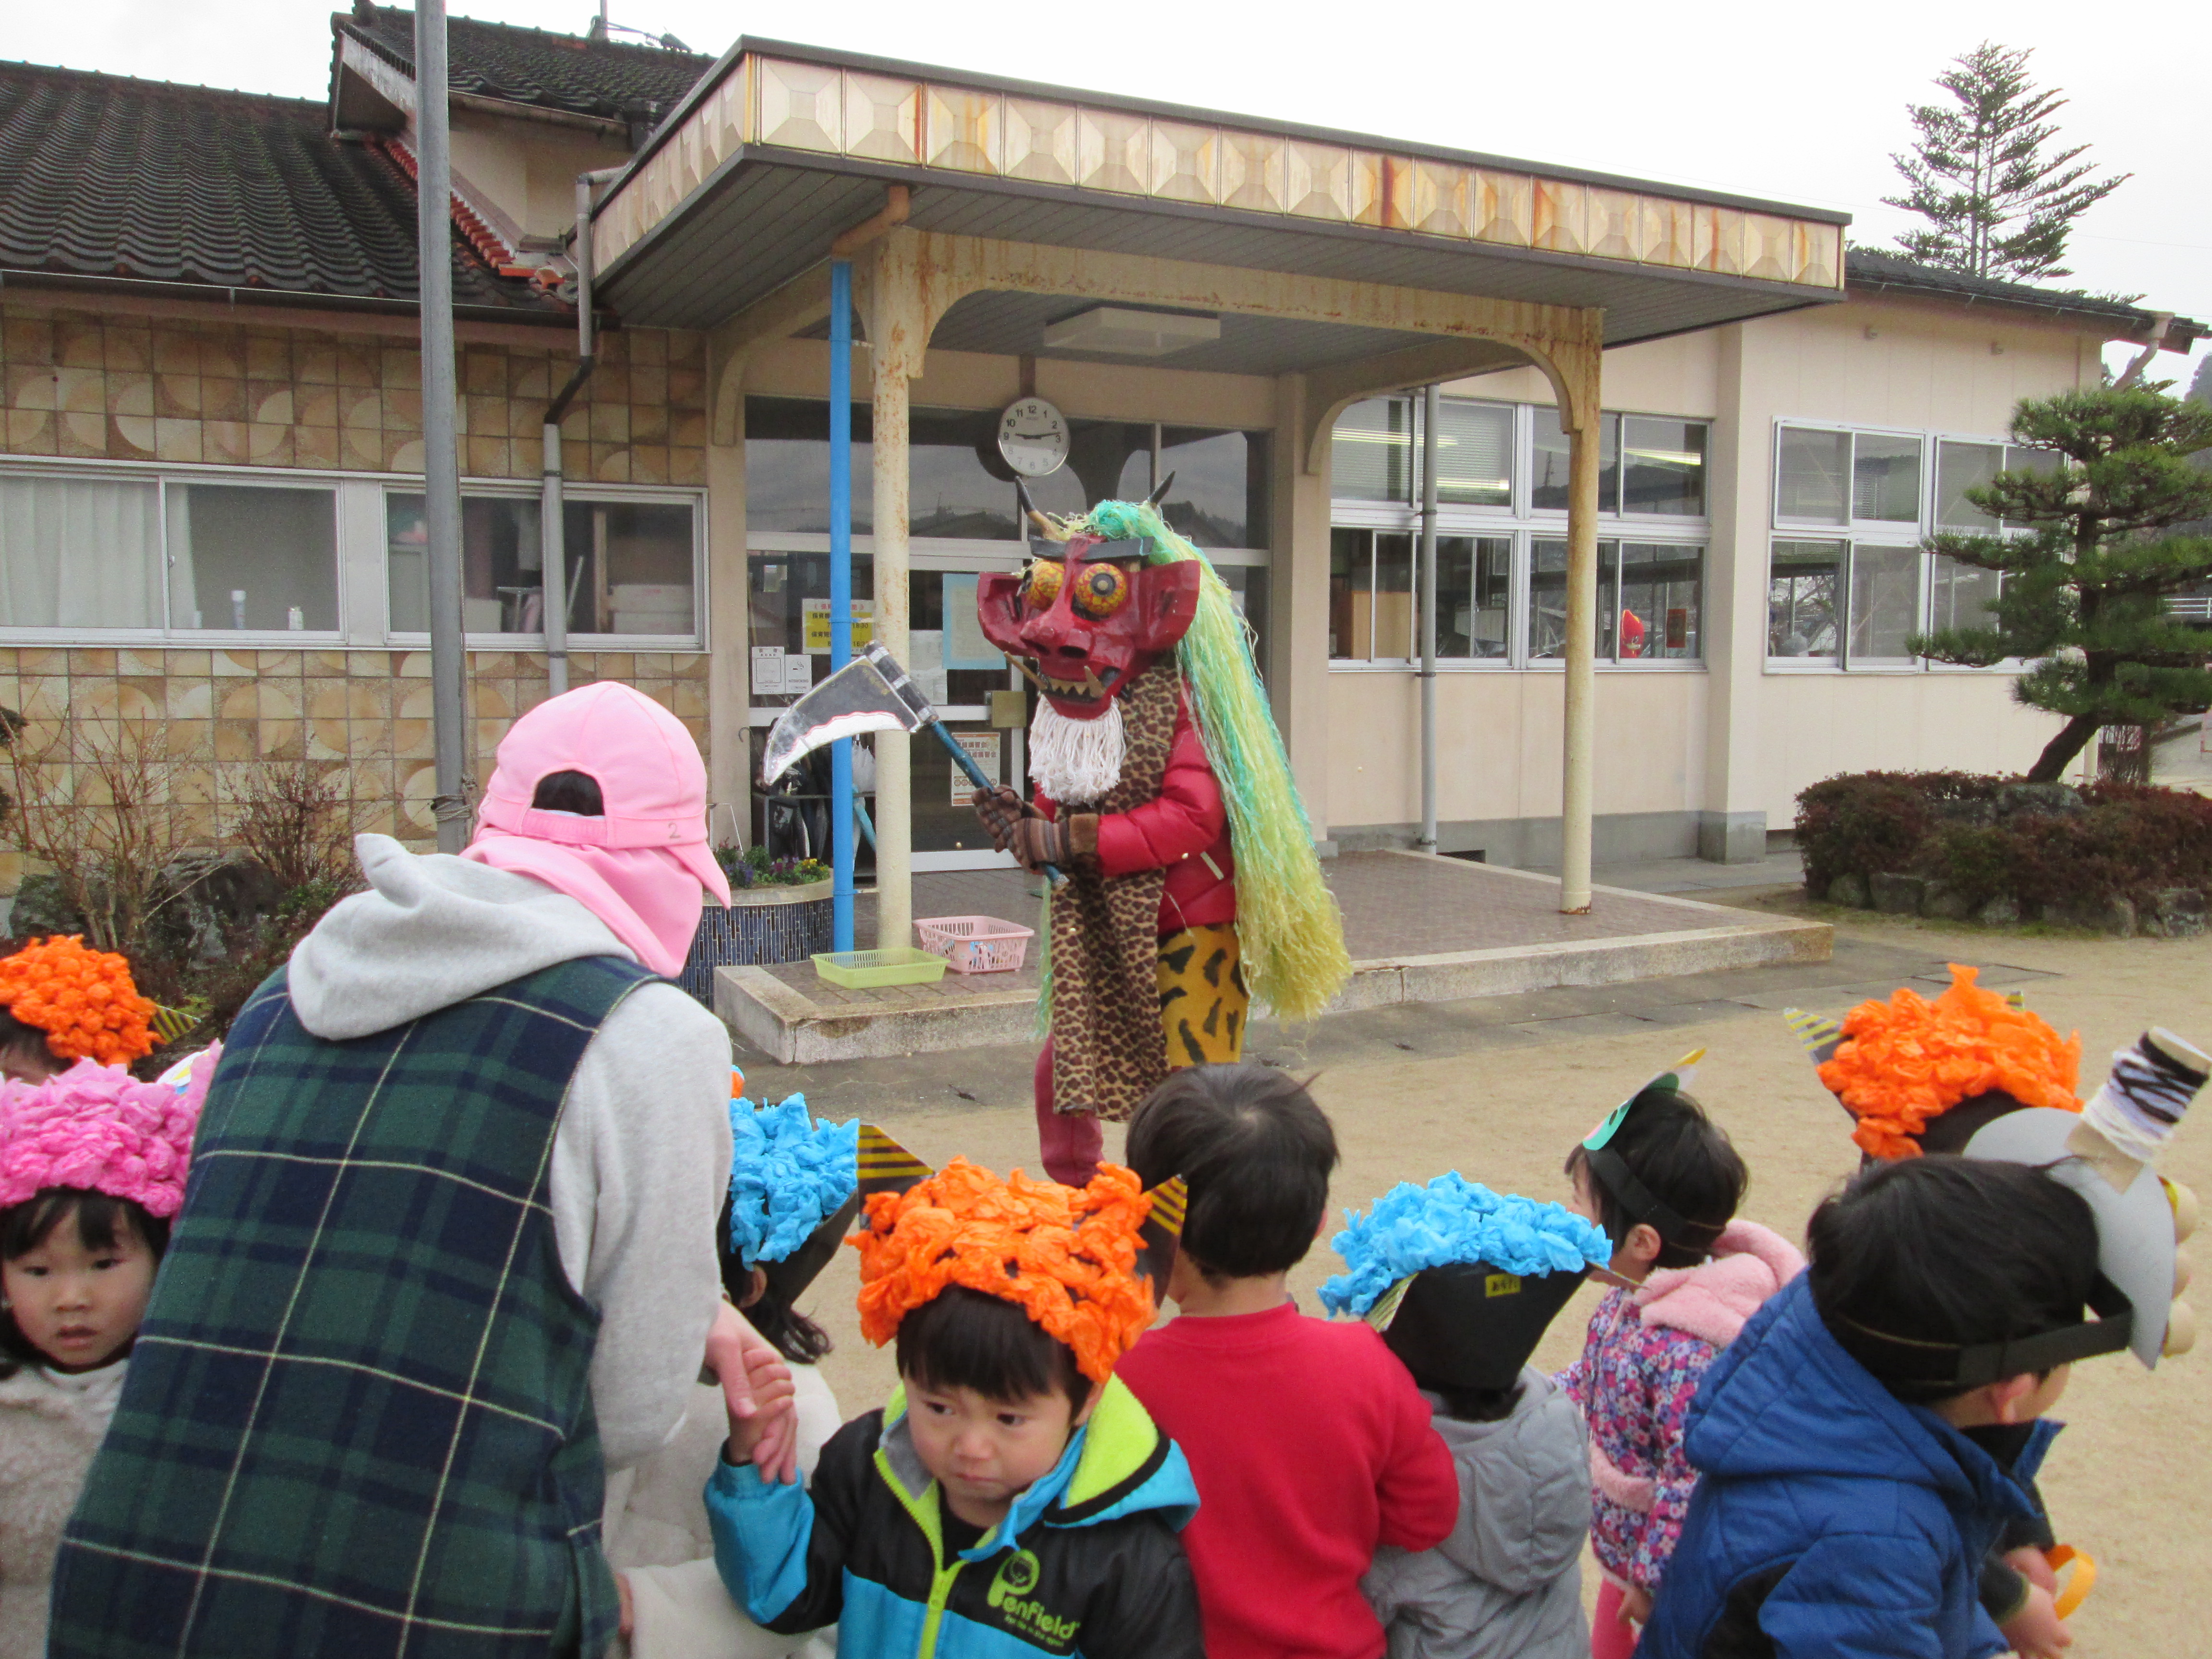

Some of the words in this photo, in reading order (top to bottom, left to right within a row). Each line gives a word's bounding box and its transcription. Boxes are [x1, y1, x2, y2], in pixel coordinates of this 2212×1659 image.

[1027, 405, 1036, 413] 12
[1044, 410, 1047, 418] 1
[1052, 421, 1057, 429] 2
[1056, 435, 1061, 443] 3
[668, 822, 681, 839] 2
